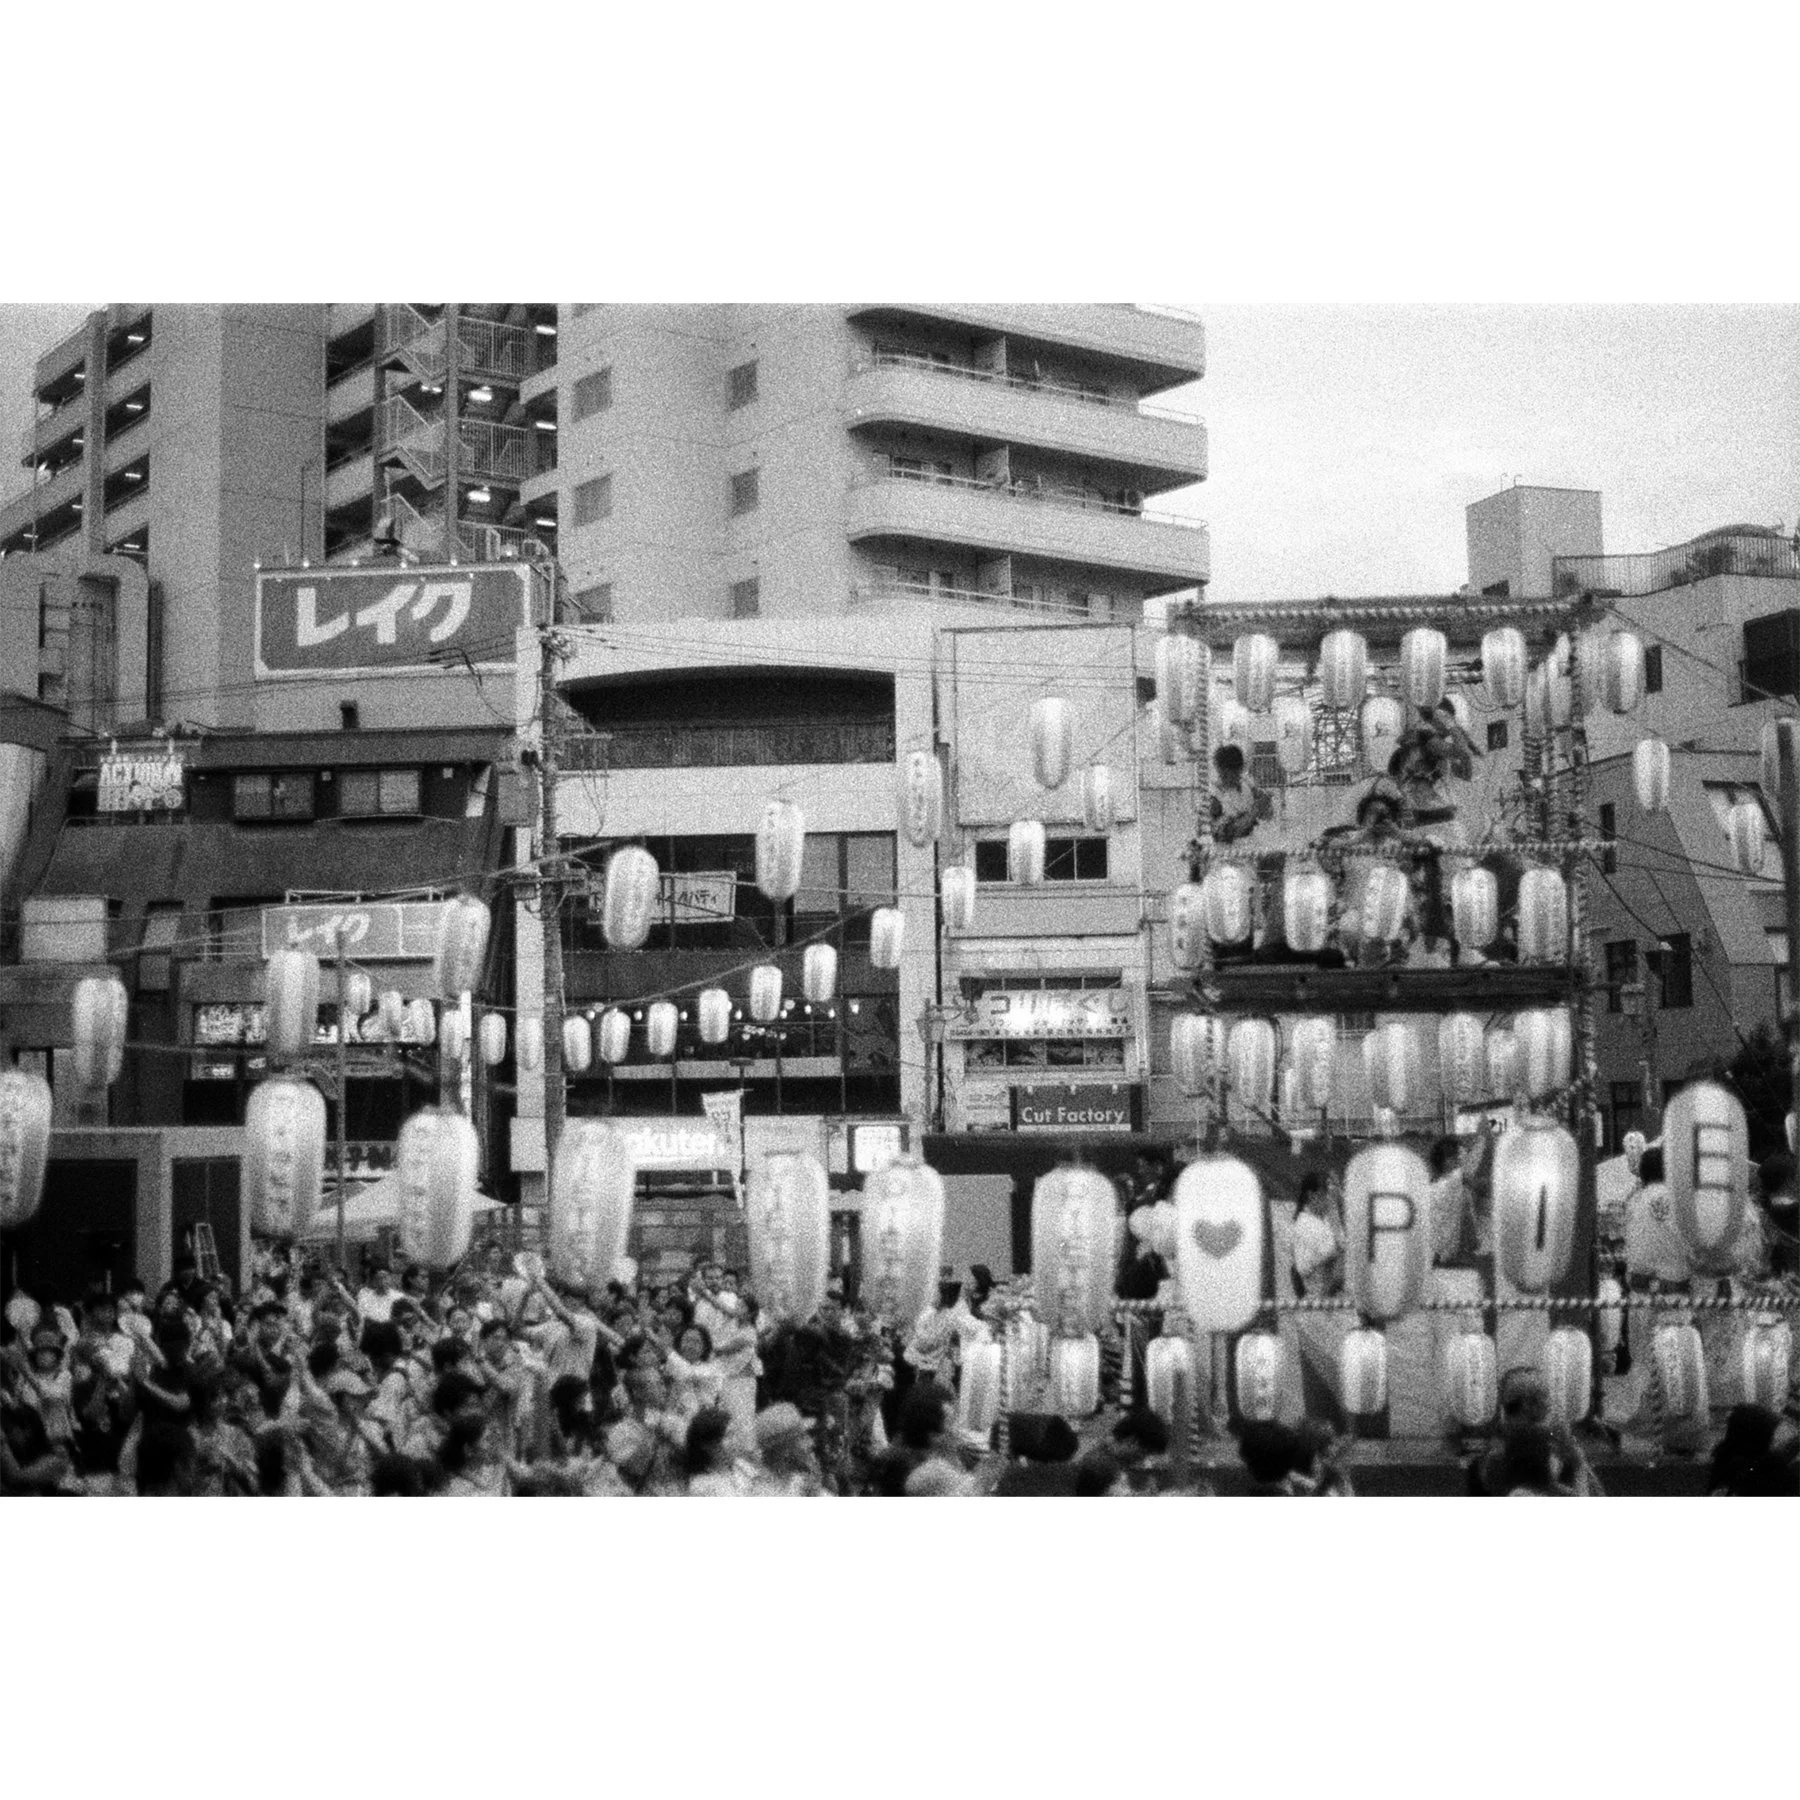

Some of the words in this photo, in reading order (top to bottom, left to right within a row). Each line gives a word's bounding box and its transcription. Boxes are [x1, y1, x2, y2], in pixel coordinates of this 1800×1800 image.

[298, 582, 472, 646] レイク
[288, 914, 370, 943] レイク
[1021, 1107, 1052, 1123] Cut
[1057, 1106, 1124, 1125] Factory
[1693, 1123, 1731, 1189] E
[1369, 1191, 1415, 1262] P
